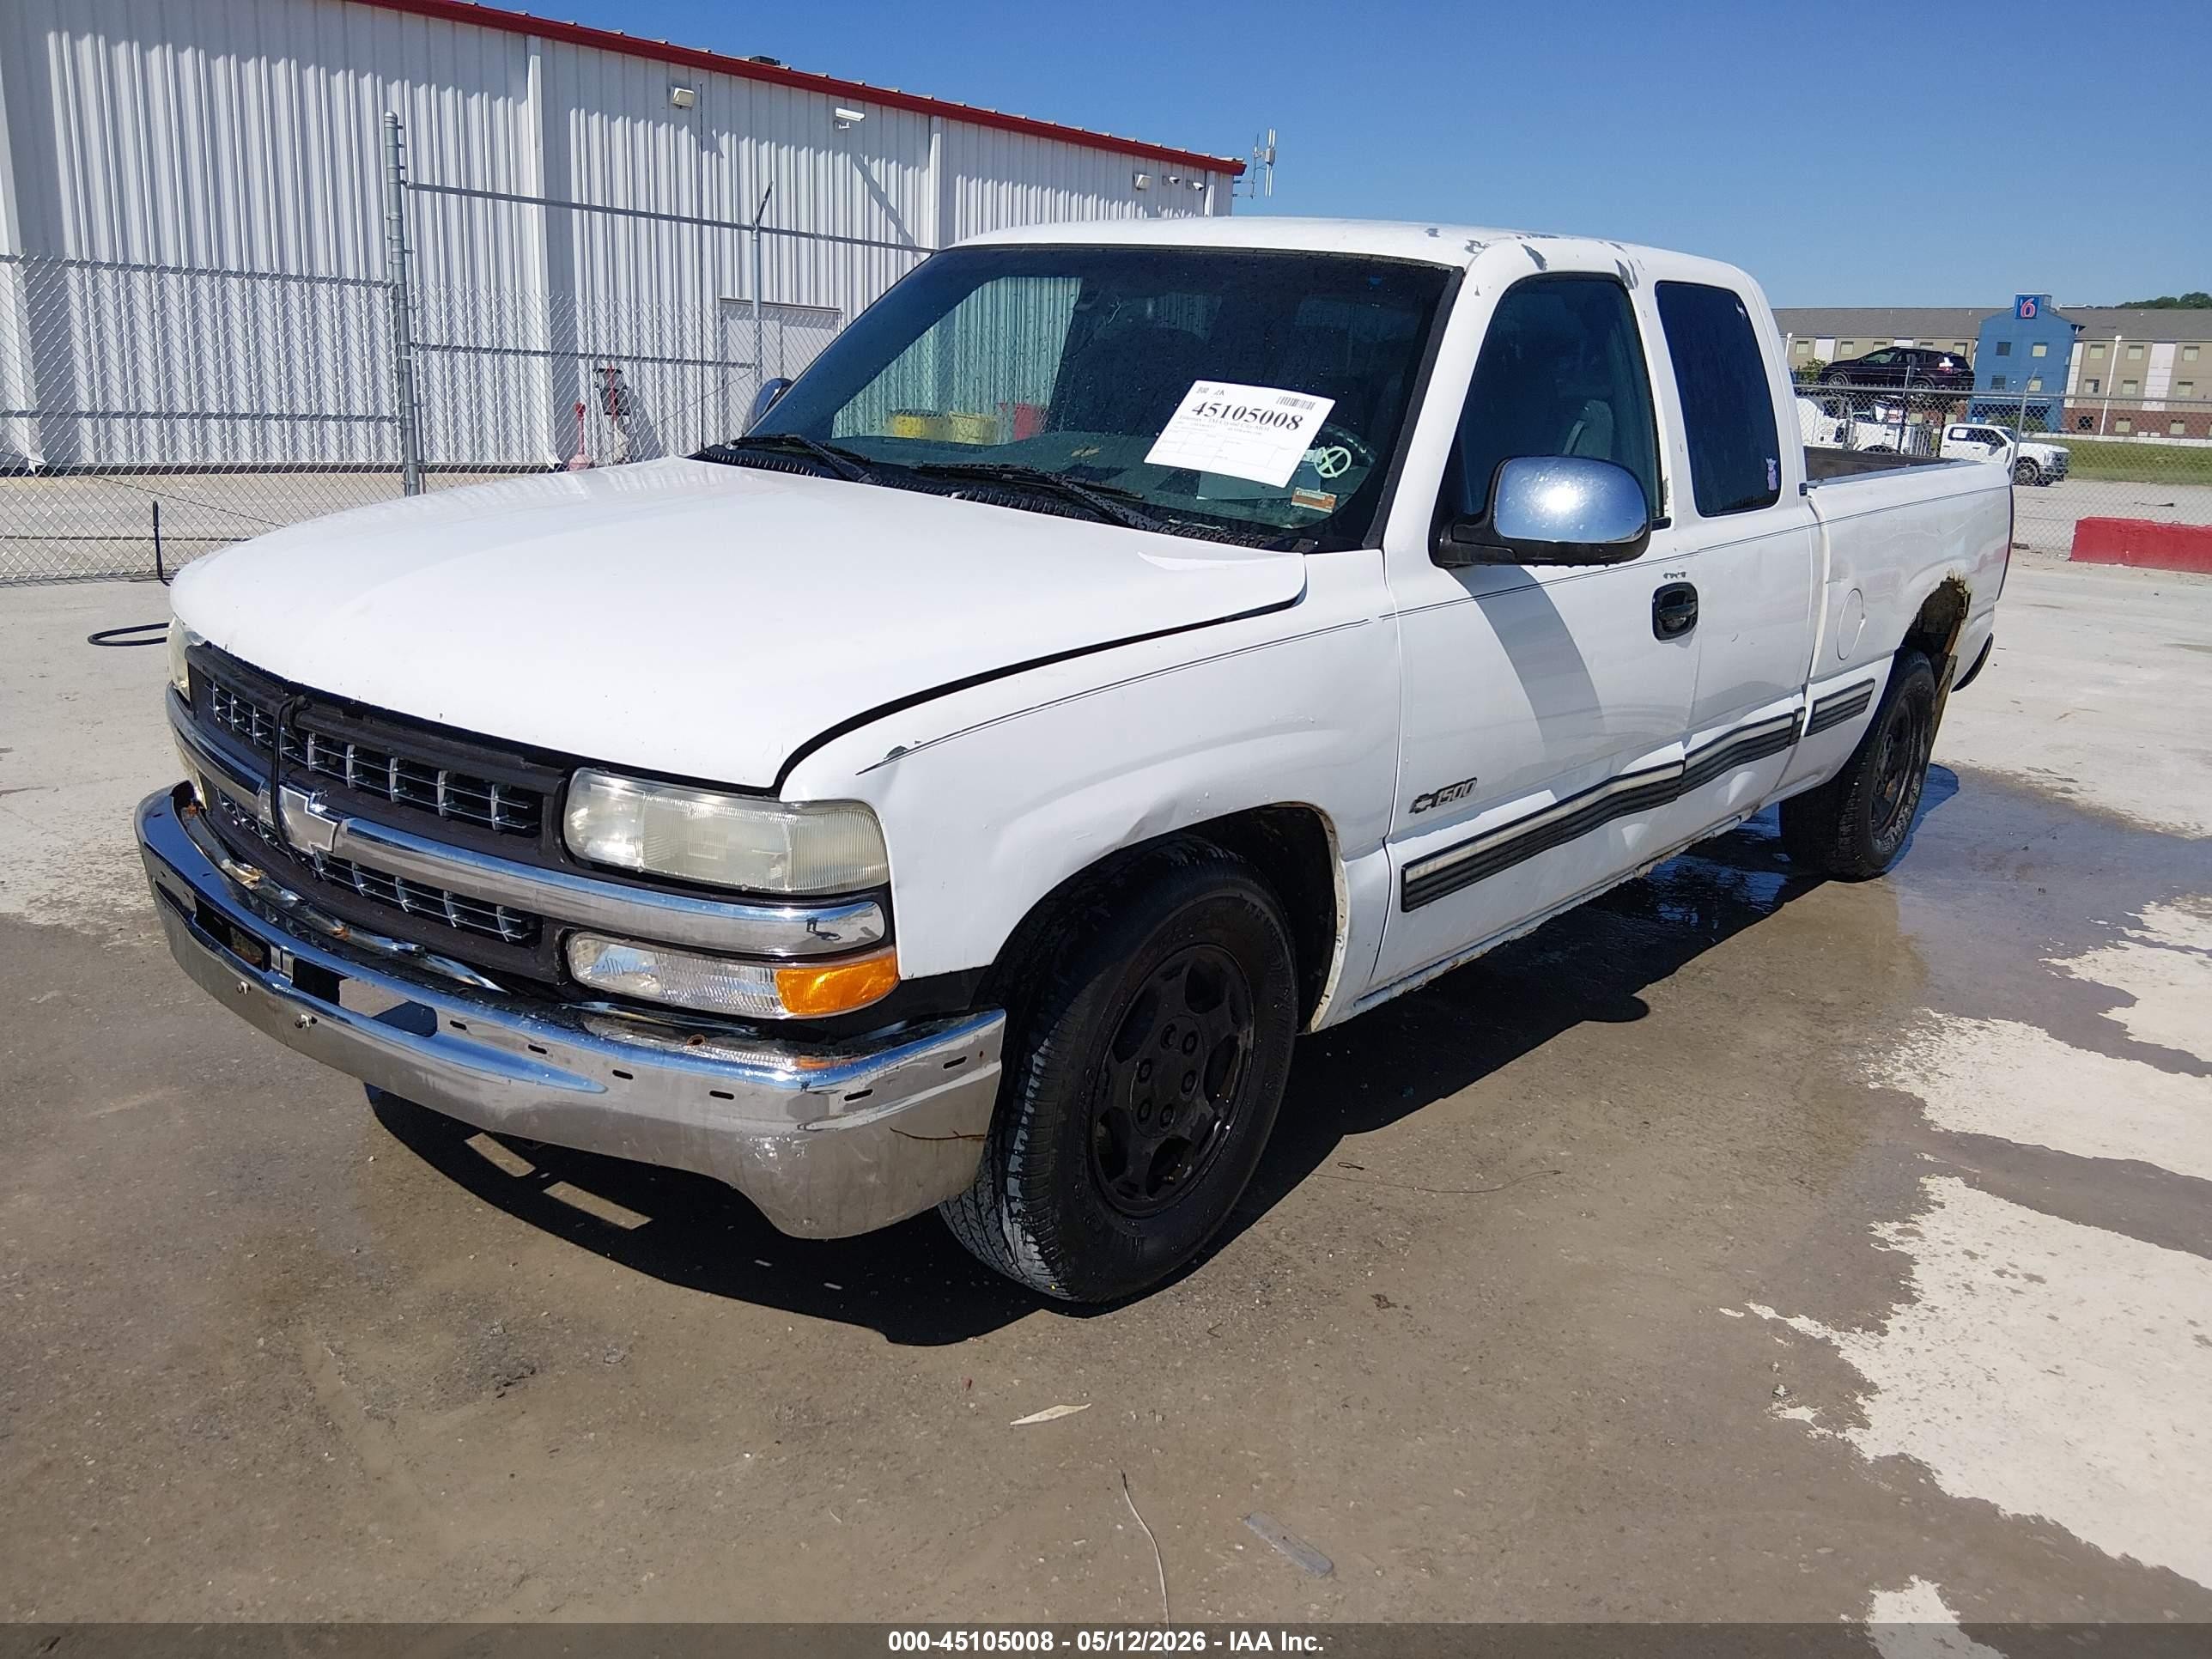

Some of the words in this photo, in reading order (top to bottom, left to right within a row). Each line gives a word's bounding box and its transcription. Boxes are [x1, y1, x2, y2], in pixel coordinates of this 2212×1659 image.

[2021, 297, 2035, 318] 6
[1192, 401, 1304, 430] 45105008
[1435, 778, 1477, 806] 1500
